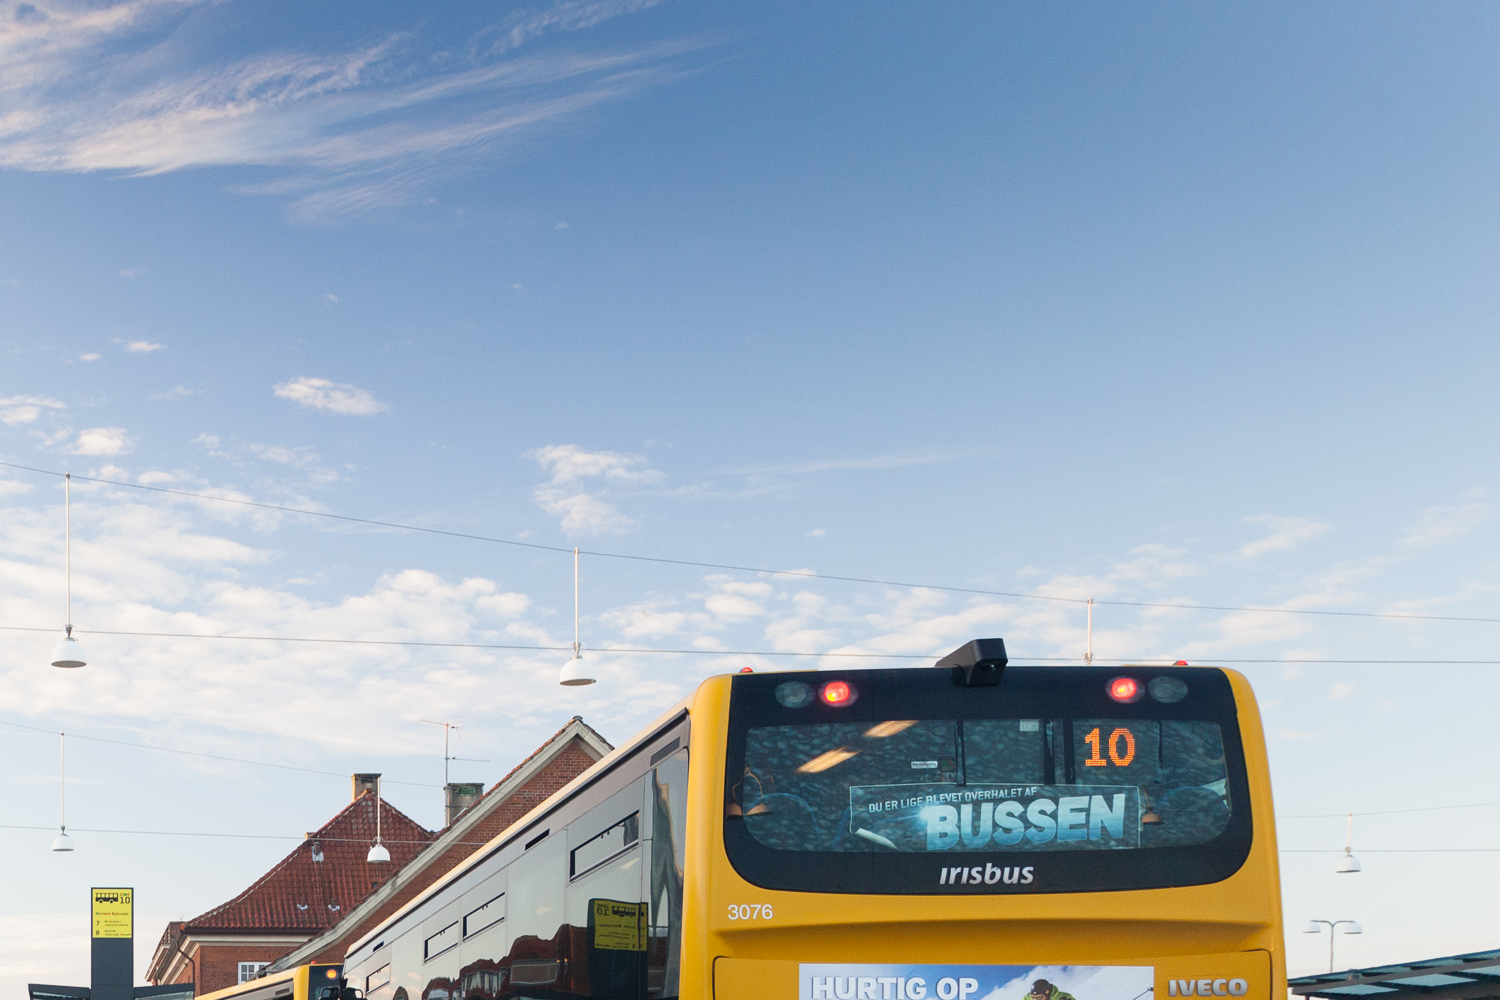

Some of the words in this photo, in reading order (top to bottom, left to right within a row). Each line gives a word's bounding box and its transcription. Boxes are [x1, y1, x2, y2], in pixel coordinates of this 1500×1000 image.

[1084, 728, 1135, 767] 10
[868, 803, 883, 813] DU
[885, 800, 898, 811] ER
[900, 797, 923, 809] LIGE
[925, 792, 963, 804] BLEVET
[964, 788, 1023, 801] OVERHALET
[1024, 786, 1037, 797] AF
[925, 793, 1125, 850] BUSSEN
[939, 863, 1034, 885] irisbus
[727, 904, 773, 920] 3076
[811, 976, 927, 1000] HURTIG
[935, 977, 978, 1000] OP
[1168, 978, 1248, 997] IVECO
